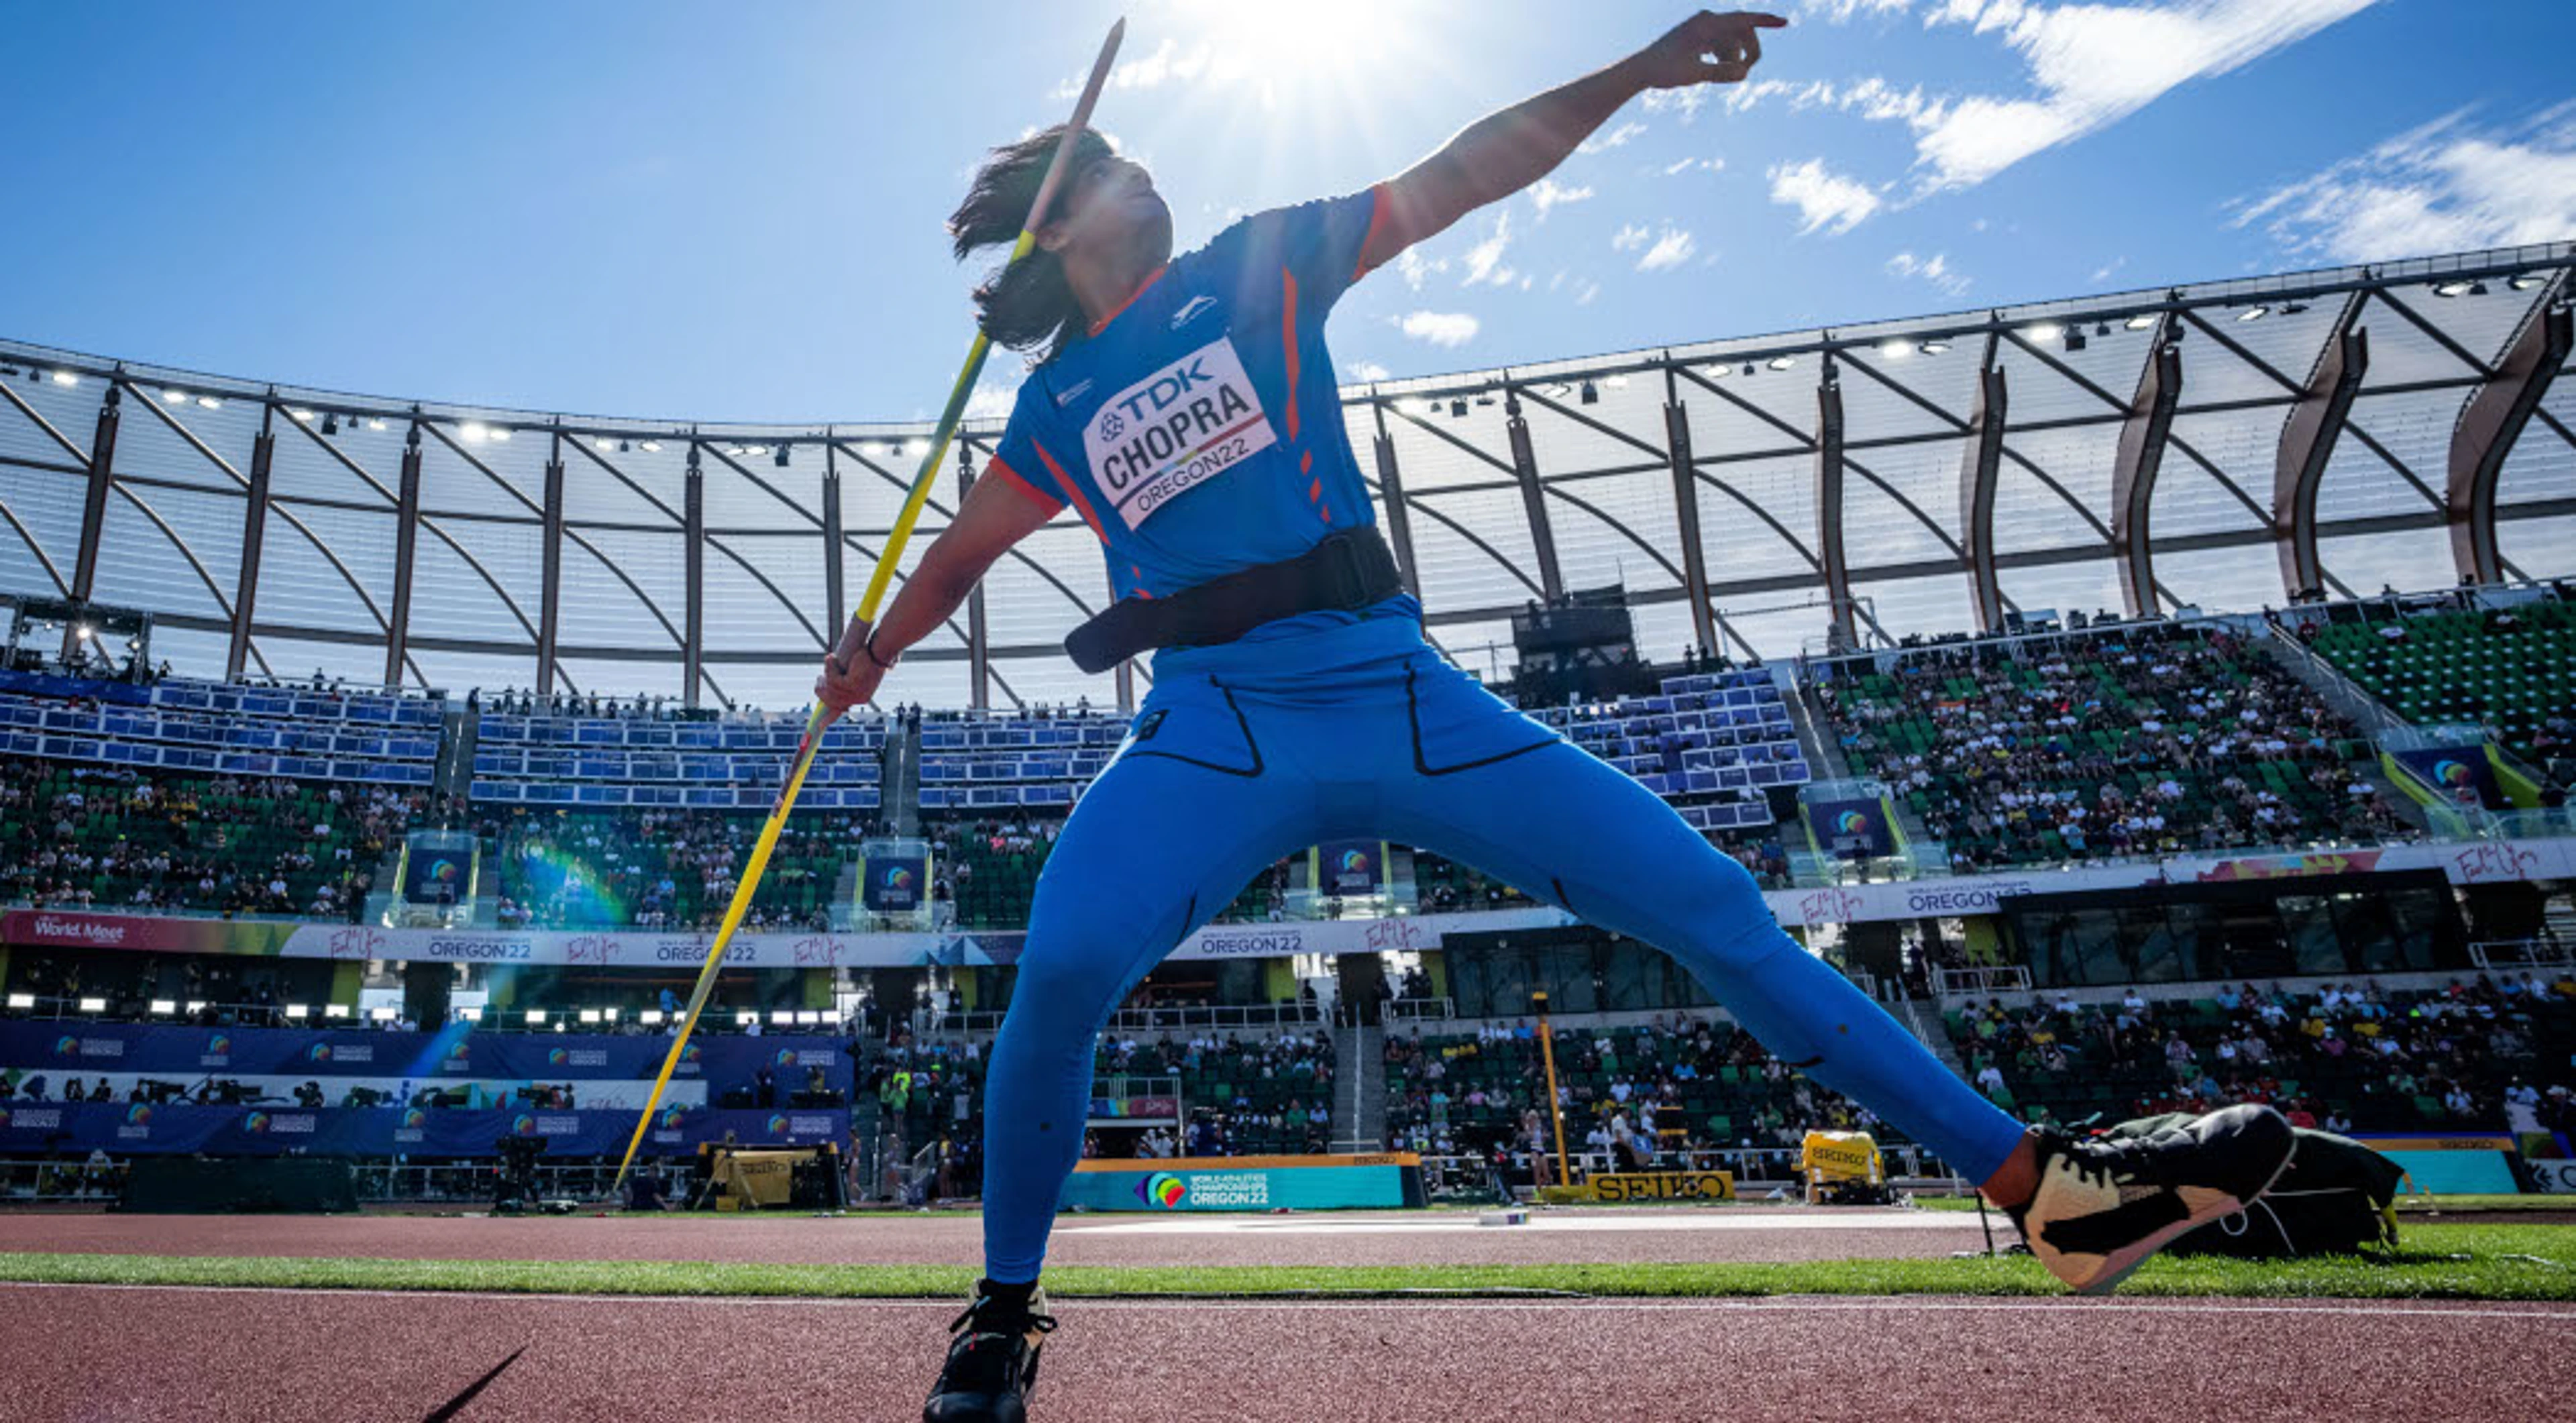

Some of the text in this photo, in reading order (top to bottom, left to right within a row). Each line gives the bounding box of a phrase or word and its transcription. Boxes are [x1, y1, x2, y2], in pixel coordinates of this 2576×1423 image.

[1116, 356, 1215, 423] TDK
[1103, 382, 1251, 490] CHOPRA
[1137, 437, 1250, 512] OREGON22
[1190, 1192, 1269, 1205] OREGON22
[1597, 1175, 1725, 1201] SEIKO
